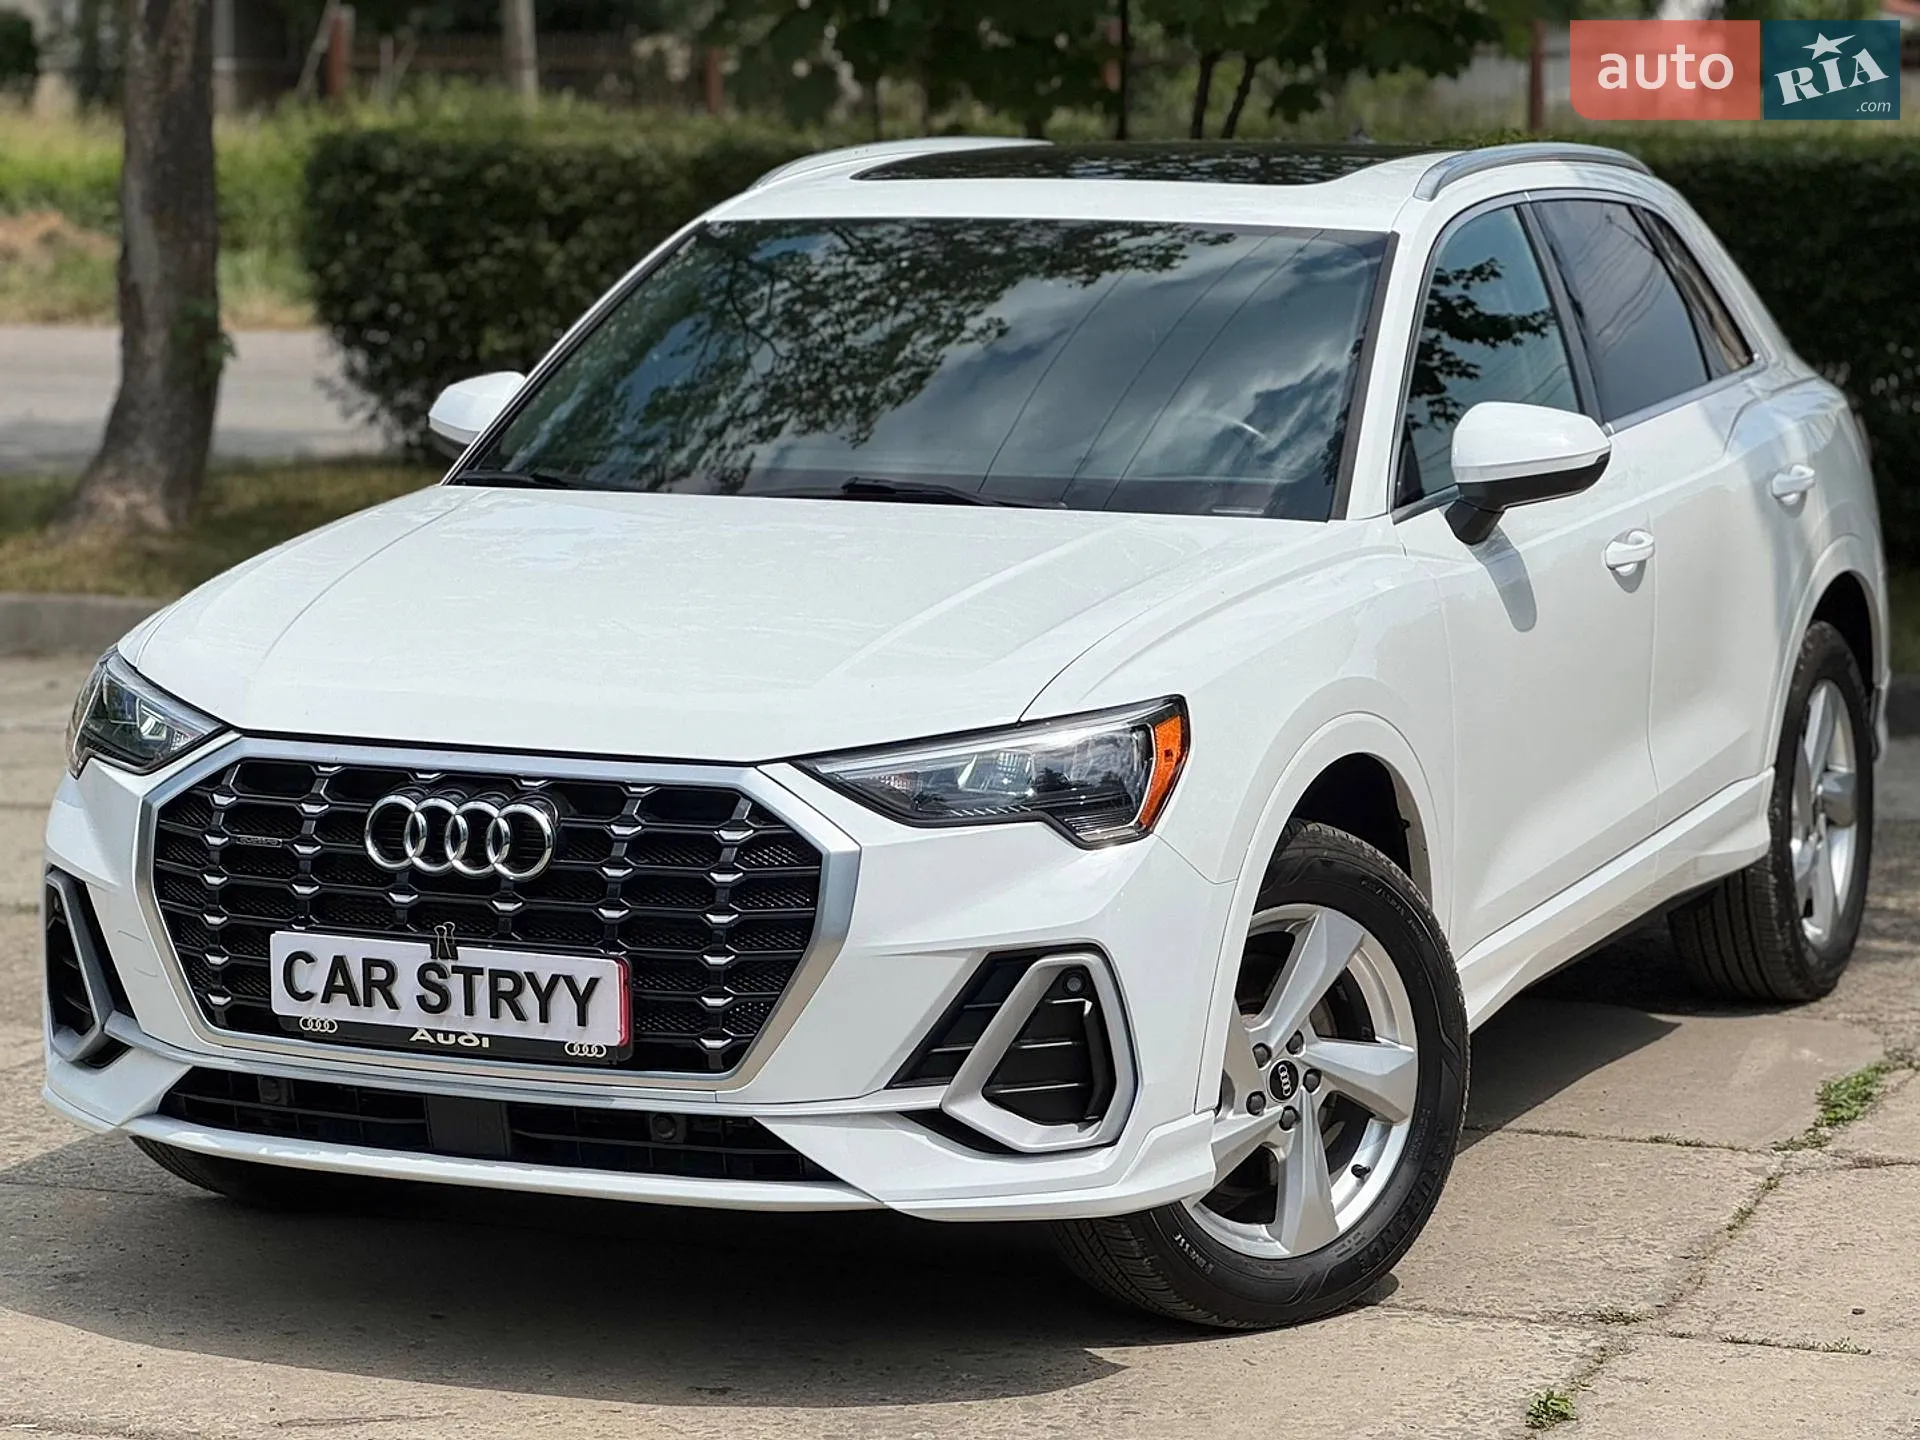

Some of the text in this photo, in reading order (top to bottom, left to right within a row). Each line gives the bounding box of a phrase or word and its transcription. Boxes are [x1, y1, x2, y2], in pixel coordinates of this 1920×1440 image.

[282, 950, 600, 1027] CAR STRYY
[409, 1028, 490, 1048] Audi
